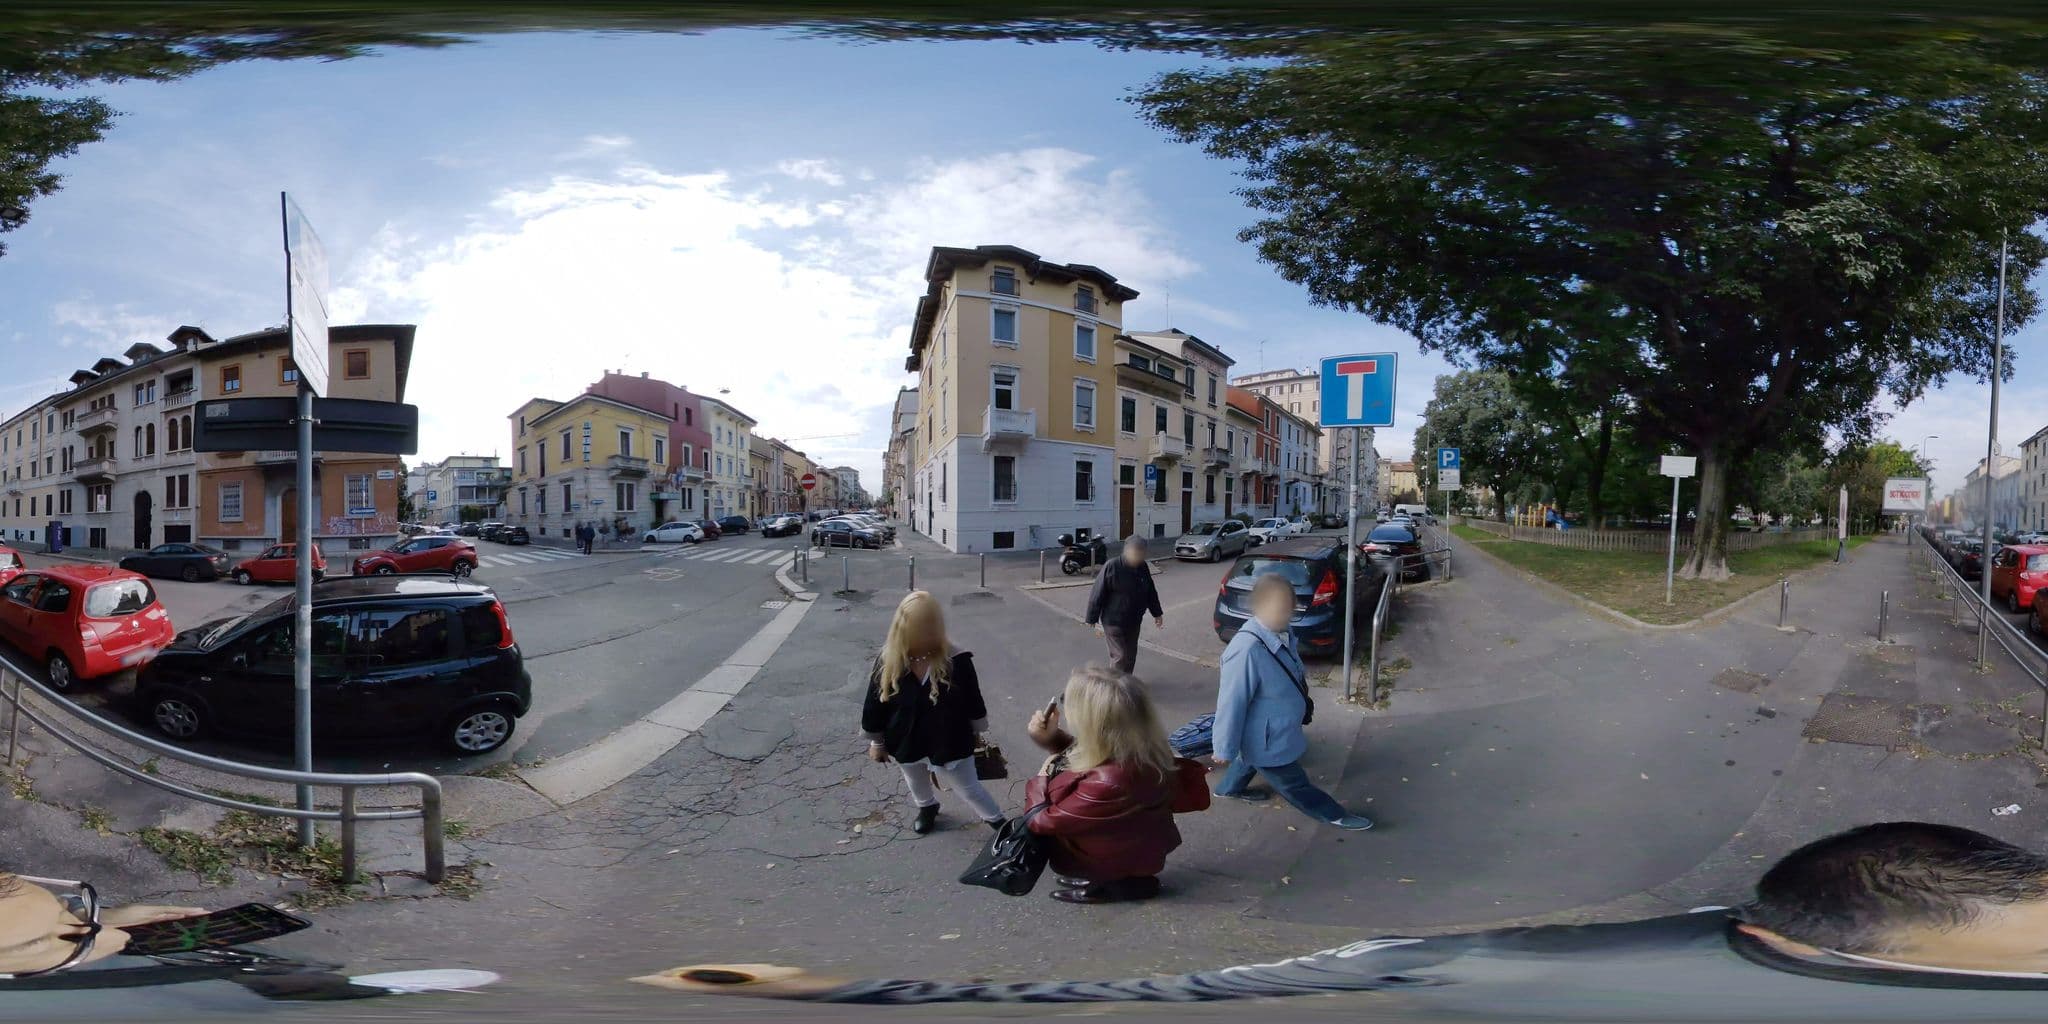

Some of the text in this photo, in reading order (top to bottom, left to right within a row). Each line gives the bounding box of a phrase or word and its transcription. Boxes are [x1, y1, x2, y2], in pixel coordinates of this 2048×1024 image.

[1443, 450, 1455, 466] P
[1147, 466, 1154, 477] P
[429, 491, 435, 499] P
